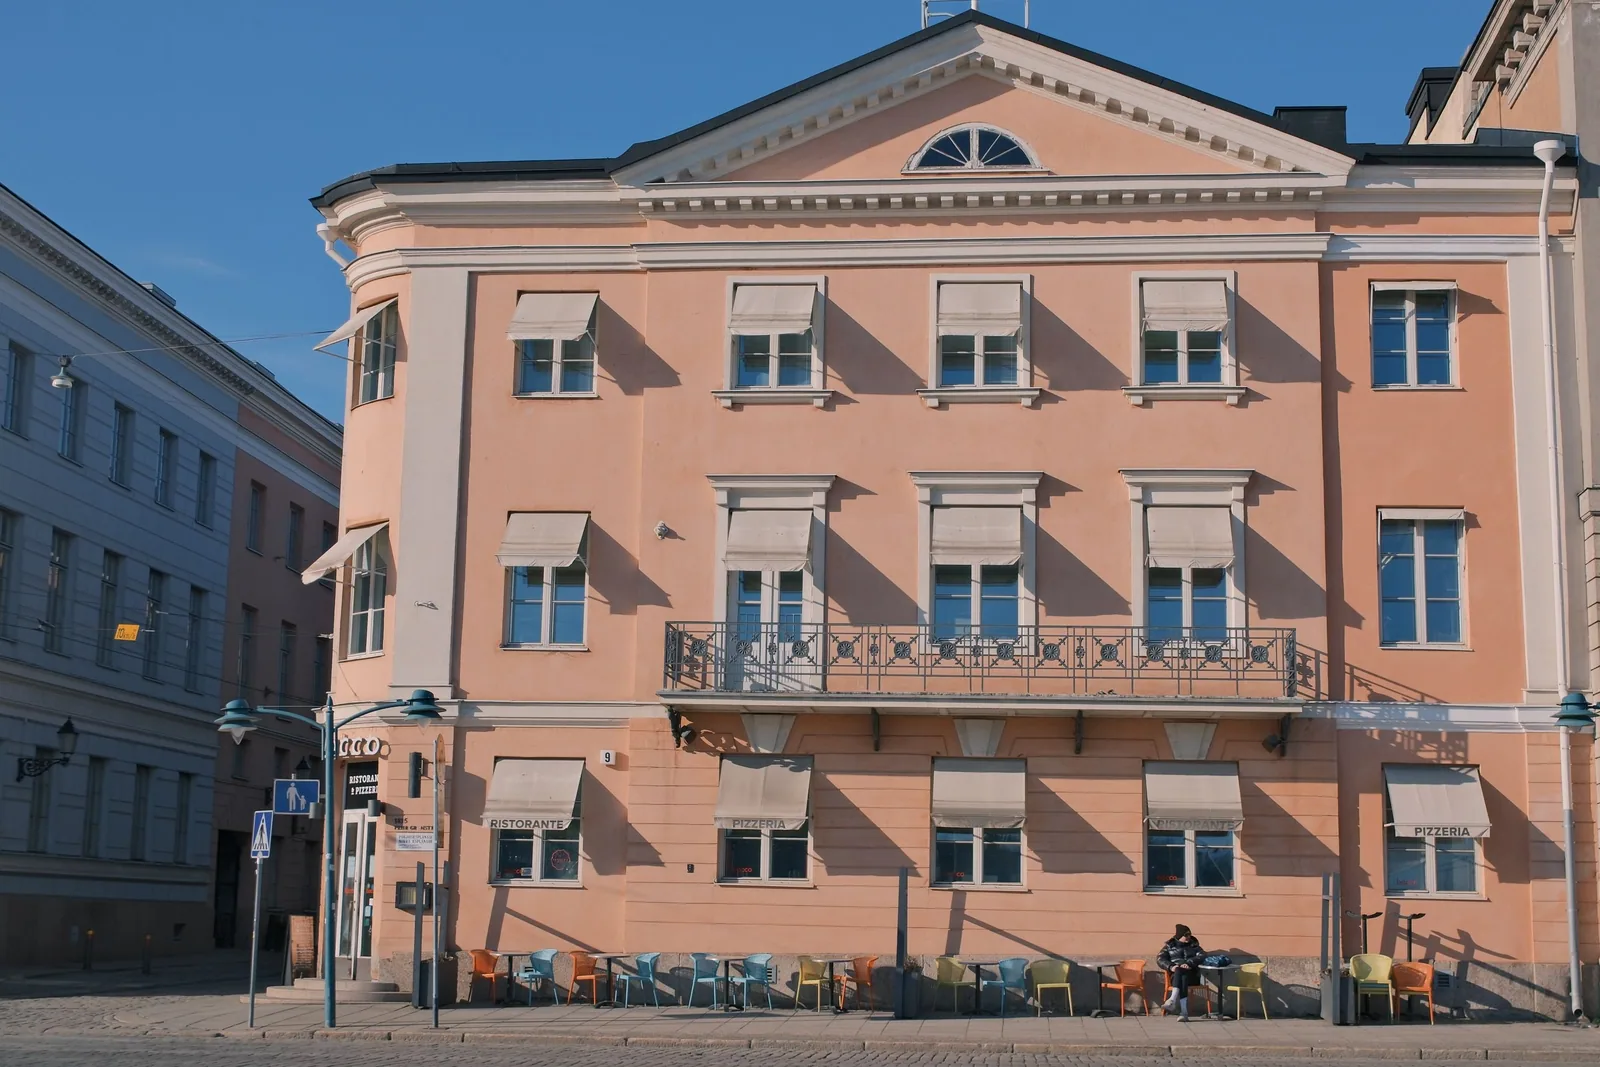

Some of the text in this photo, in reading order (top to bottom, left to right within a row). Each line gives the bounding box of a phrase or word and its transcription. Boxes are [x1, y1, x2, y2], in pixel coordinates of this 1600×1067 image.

[604, 751, 611, 763] 9
[490, 819, 564, 829] RISTORANTE
[732, 819, 786, 829] PIZZERIA
[1157, 819, 1235, 830] RISTORANTE
[1414, 827, 1471, 837] PIZZERIA
